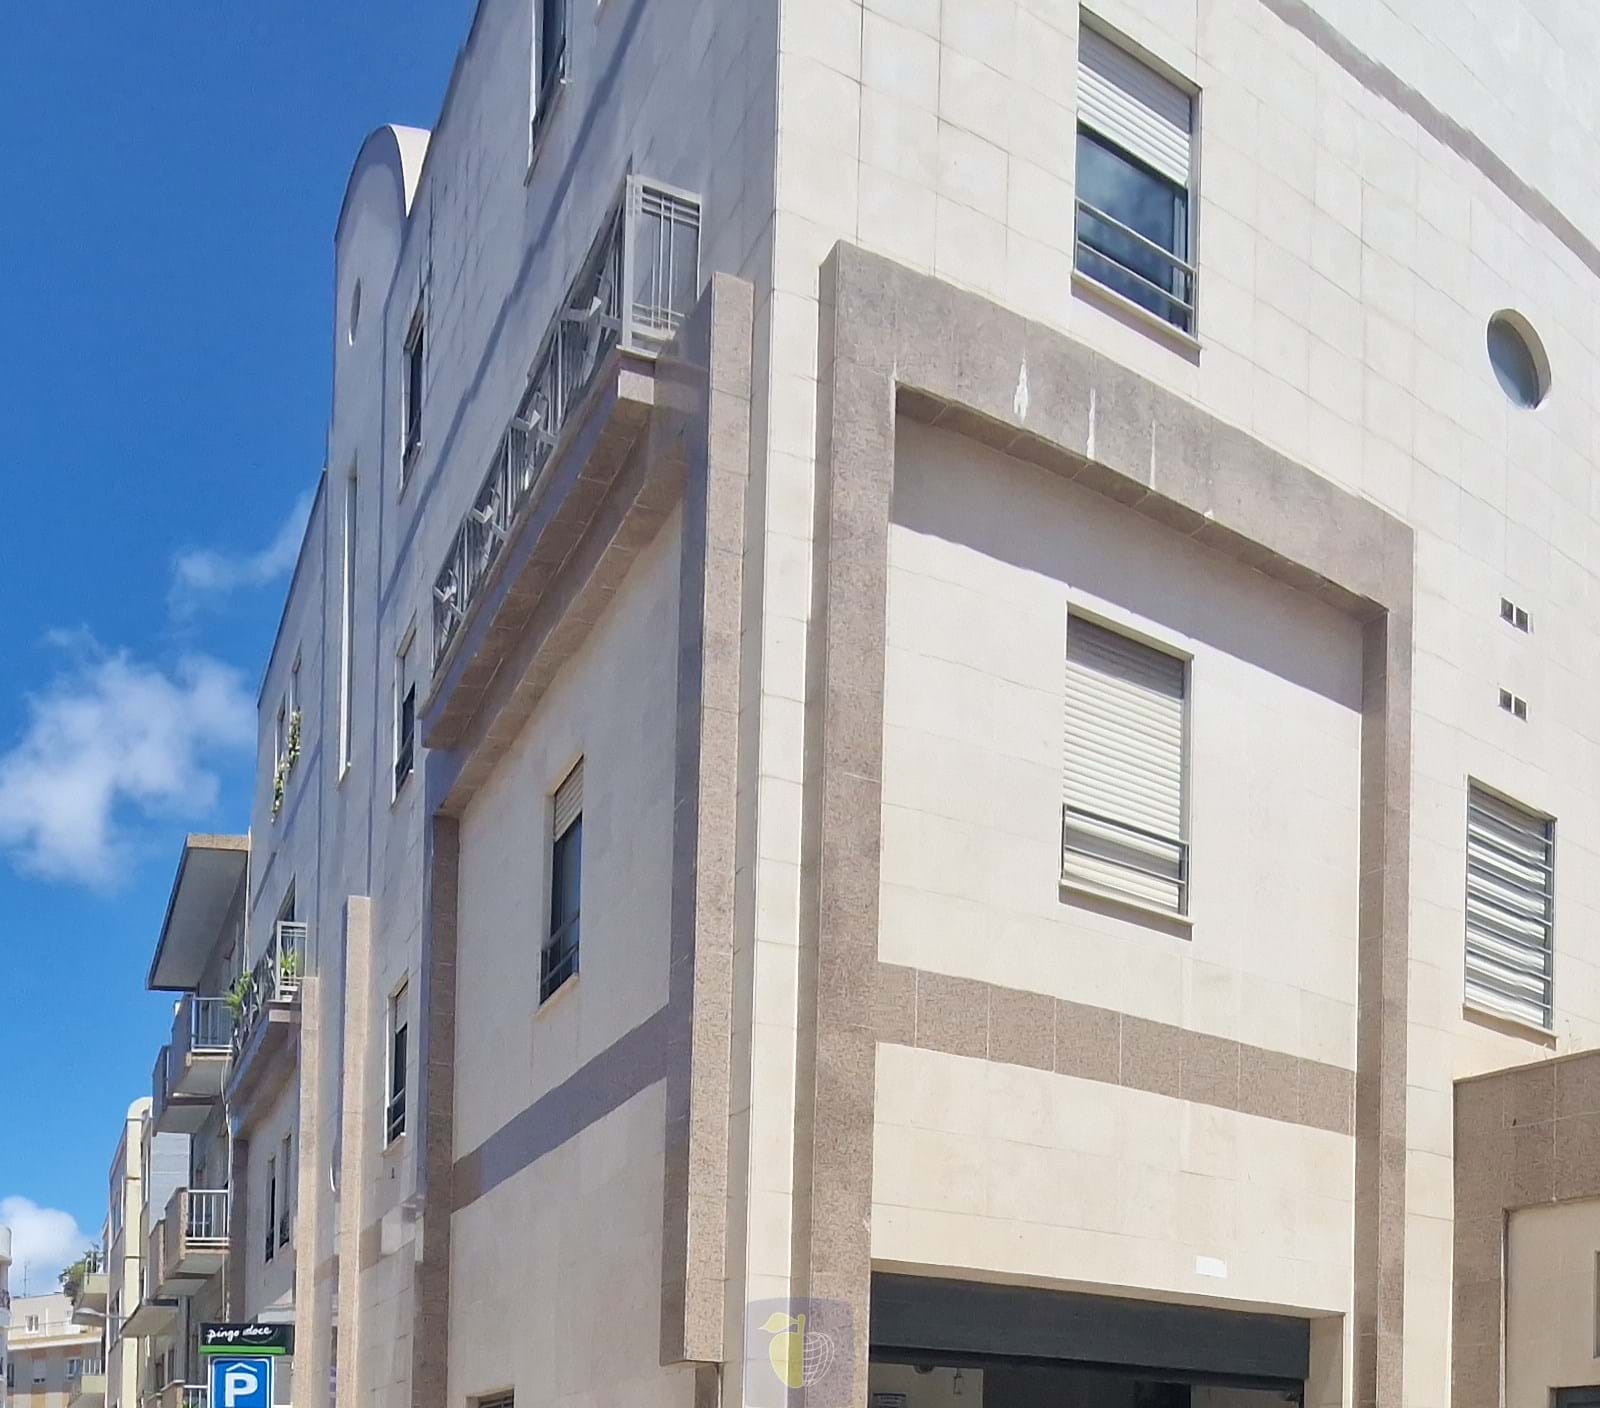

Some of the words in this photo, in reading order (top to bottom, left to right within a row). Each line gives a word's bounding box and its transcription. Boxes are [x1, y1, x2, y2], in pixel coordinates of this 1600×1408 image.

[206, 1327, 240, 1344] pingo
[242, 1323, 273, 1336] doce
[224, 1372, 259, 1408] P
